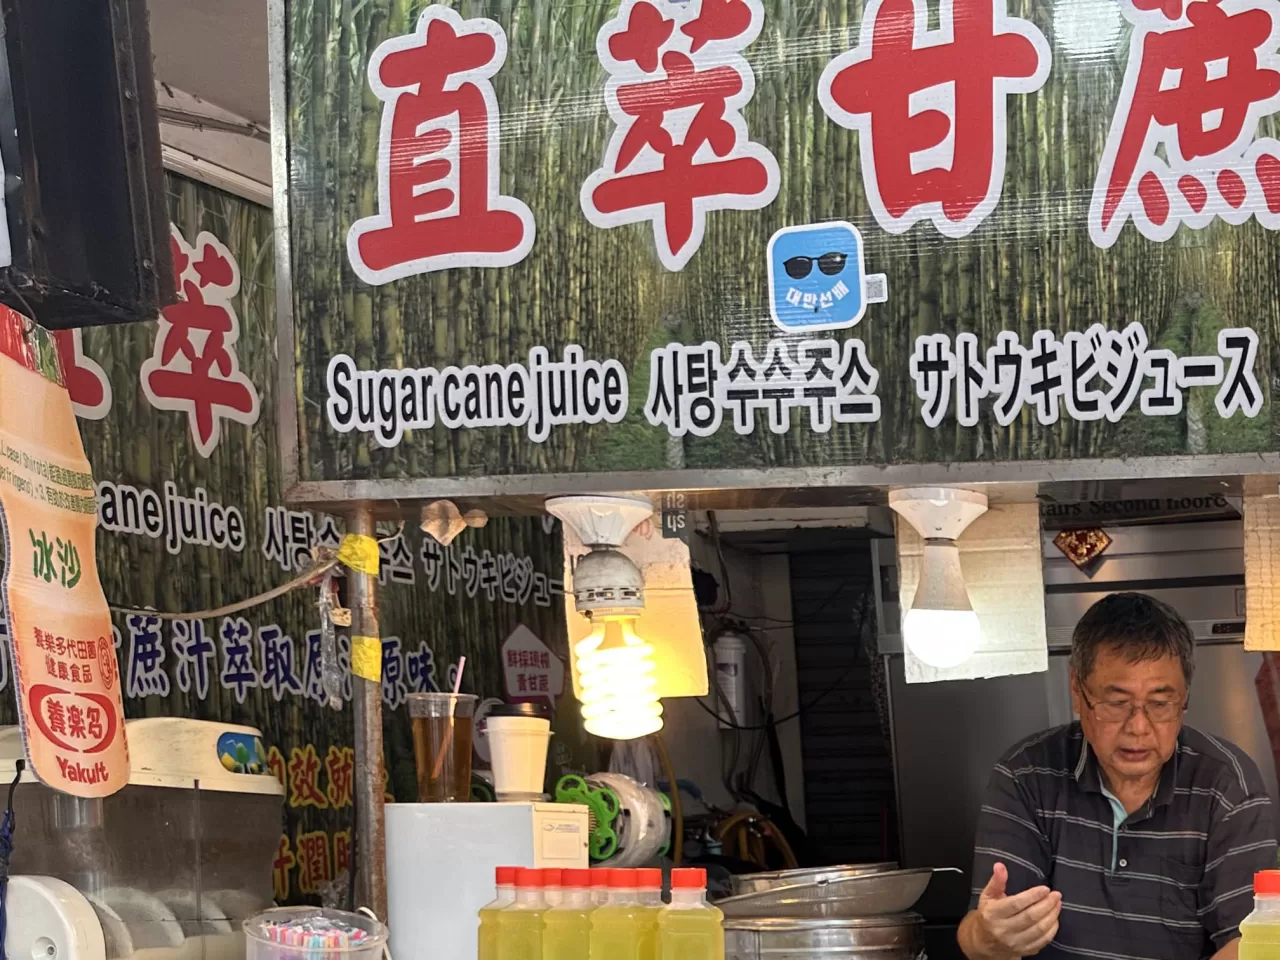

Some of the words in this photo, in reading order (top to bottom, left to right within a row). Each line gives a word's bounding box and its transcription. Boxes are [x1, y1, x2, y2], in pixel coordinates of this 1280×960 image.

[785, 279, 850, 309] 대만선배
[332, 362, 433, 440] Sugar
[441, 375, 524, 423] cane
[530, 350, 624, 438] juice
[652, 345, 878, 429] 사탕수수주스
[917, 331, 1257, 421] サトウキビジュース
[100, 486, 162, 533] ane
[167, 483, 244, 548] juice
[28, 527, 82, 588] 冰沙
[46, 654, 94, 684] 健康食品
[56, 755, 110, 785] Yakult
